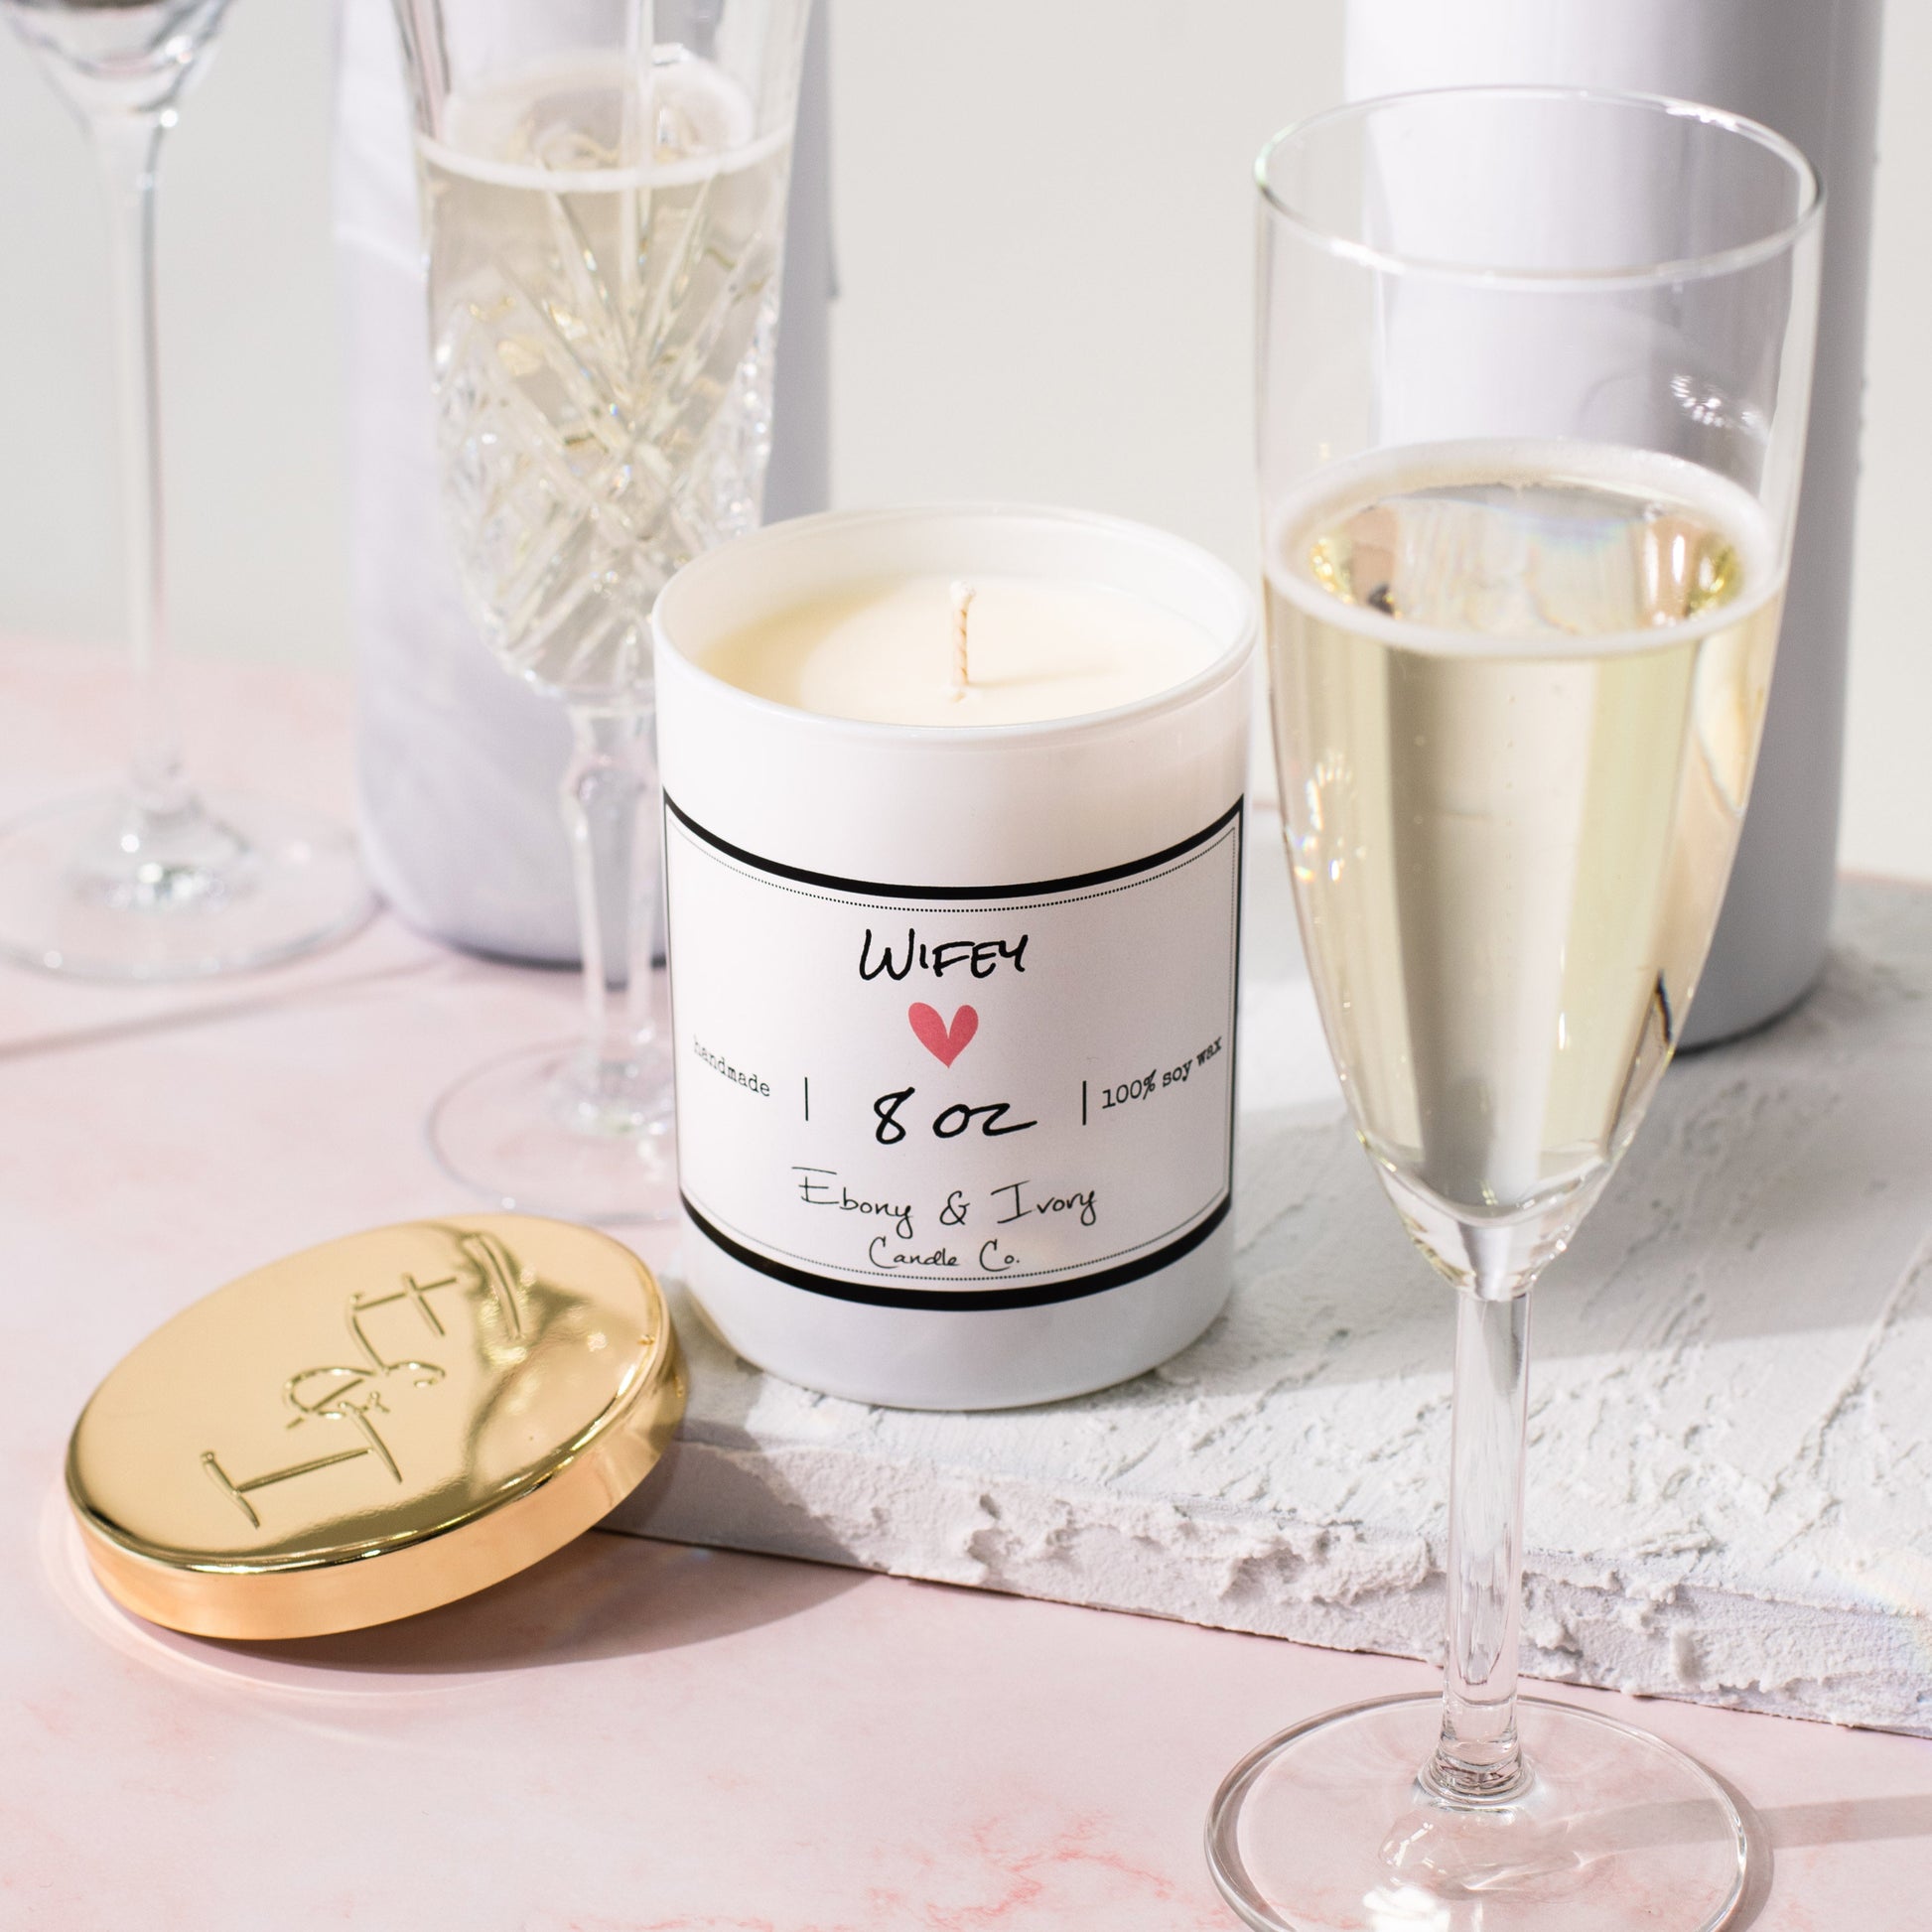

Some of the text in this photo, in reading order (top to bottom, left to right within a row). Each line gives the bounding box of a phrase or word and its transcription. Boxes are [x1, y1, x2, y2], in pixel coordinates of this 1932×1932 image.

[693, 1034, 770, 1097] handmade
[1101, 1035, 1223, 1110] 100% soy wax
[873, 1086, 1038, 1146] 8 oz
[790, 1167, 1097, 1240] Ebony & Ivory
[869, 1236, 1022, 1273] Candle Co.
